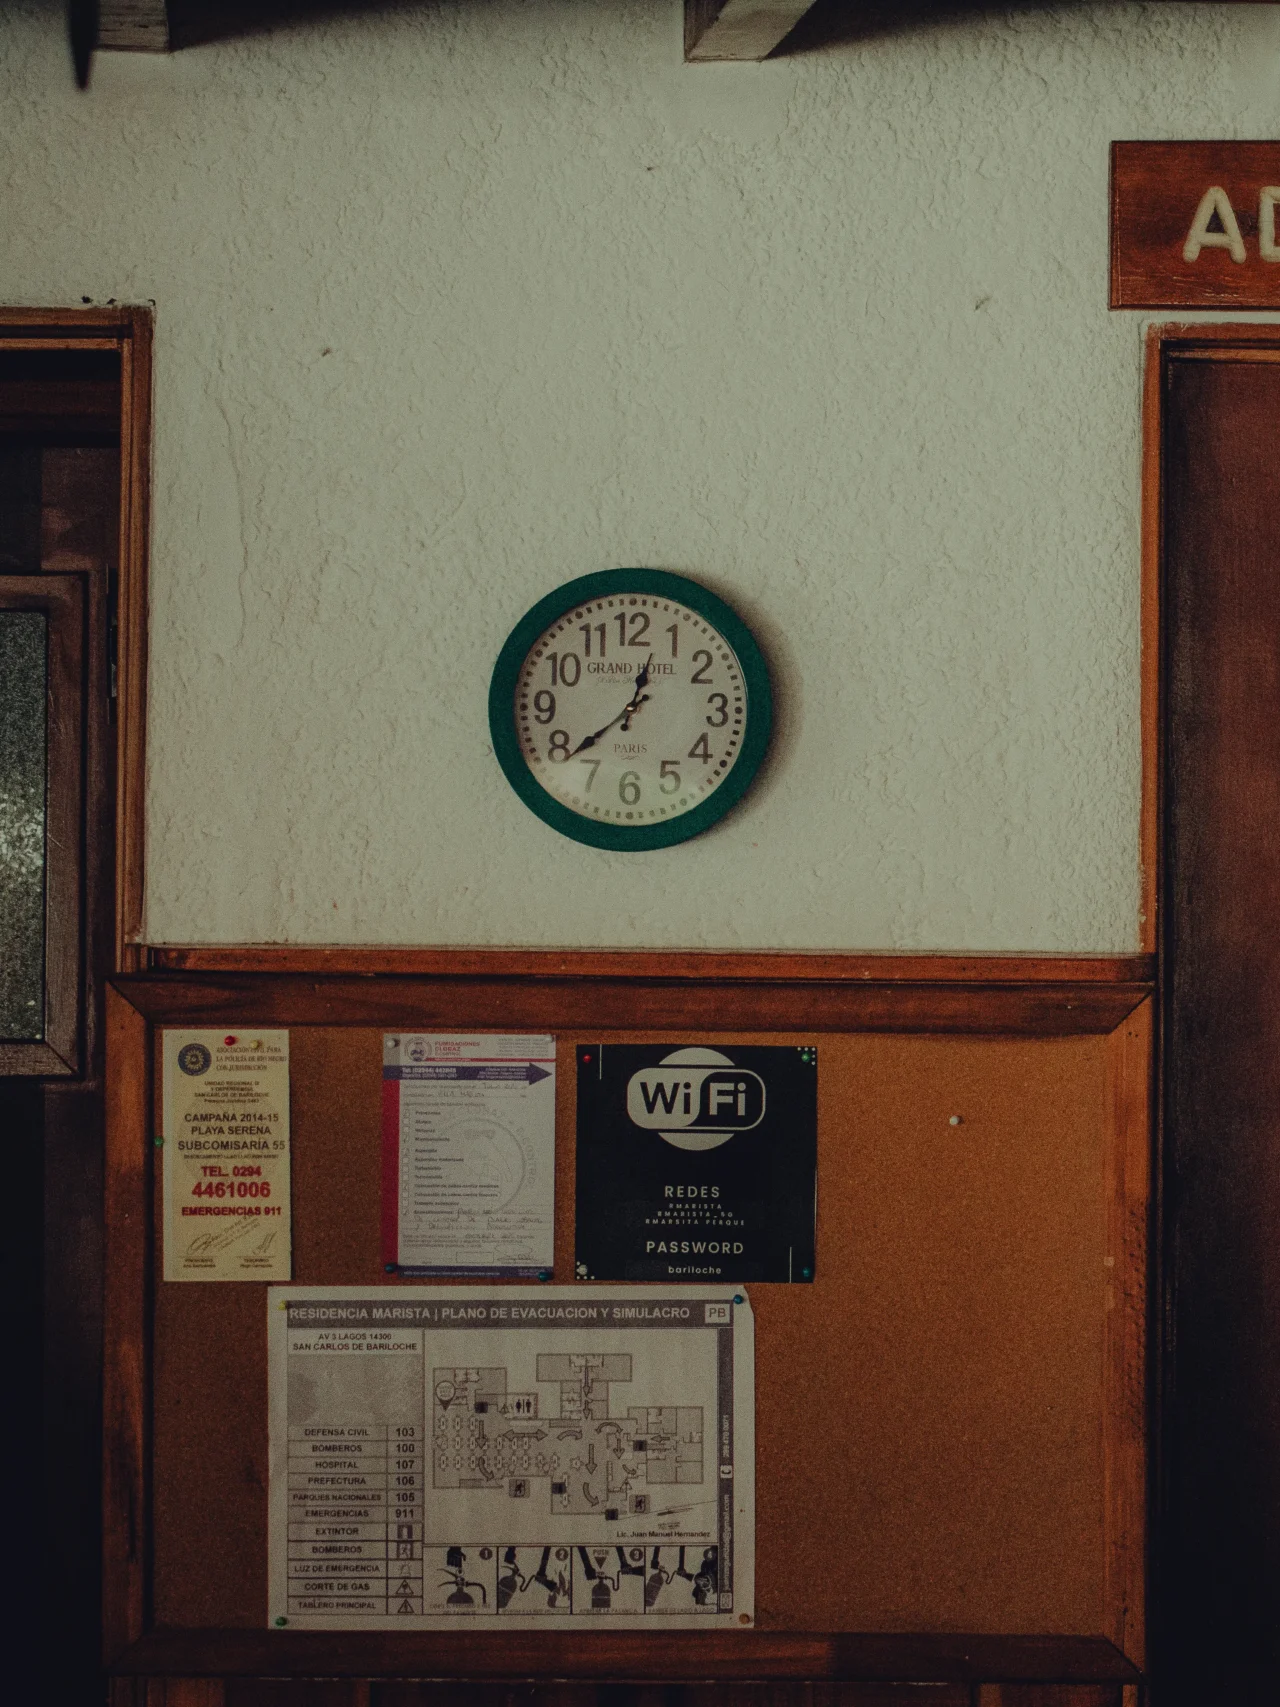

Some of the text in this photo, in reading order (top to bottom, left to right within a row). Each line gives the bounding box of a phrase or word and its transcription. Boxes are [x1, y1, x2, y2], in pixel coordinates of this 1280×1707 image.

[614, 611, 651, 647] 12
[578, 622, 607, 658] 11
[665, 622, 679, 659] 1
[545, 651, 582, 688] 10
[586, 661, 633, 675] GRAND
[690, 649, 714, 685] 2
[533, 689, 557, 725] 9
[706, 692, 729, 728] 3
[547, 728, 571, 764] 8
[613, 743, 648, 755] PARIS
[687, 732, 714, 764] 4
[579, 758, 602, 794] 7
[658, 759, 681, 796] 5
[617, 770, 641, 806] 6
[184, 1111, 280, 1123] CAMPAÑA 2014-15
[190, 1125, 272, 1136] PLAYA SERENA
[177, 1137, 287, 1151] SUBCOMISARÍA 55
[232, 1165, 264, 1177] 0294
[190, 1180, 272, 1199] 4461006
[663, 1184, 721, 1199] REDES
[181, 1205, 282, 1217] EMERGENCIAS 911
[668, 1202, 722, 1210] RMARISTA
[645, 1218, 700, 1226] RMARSITA
[645, 1240, 745, 1256] PASSWORD
[667, 1263, 723, 1276] bariloche
[289, 1307, 727, 1321] RESIDENCIA MARISTA PLANO DE EVACUACION Y SIMULACRO PB
[318, 1333, 330, 1341] AV
[338, 1333, 368, 1341] LAGOS
[293, 1343, 419, 1351] SAN CARLOS DE BARILOCHE
[304, 1427, 416, 1437] DEFENSA CIVIL 103
[311, 1443, 416, 1453] BOMBEROS 100
[314, 1459, 415, 1470] HOSPITAL 107
[307, 1475, 415, 1486] PREFECTURA 106
[292, 1492, 415, 1502] PARQUES NACIONALES 105
[304, 1508, 415, 1518] EMERGENCIAS 911
[315, 1527, 359, 1536] EXTINTOR
[629, 1530, 648, 1538] Juan
[648, 1530, 674, 1538] Manuel
[674, 1530, 712, 1539] Hernandez
[311, 1545, 363, 1554] BOMBEROS
[294, 1564, 381, 1573] LUZ DE EMERGENCIA
[304, 1582, 370, 1591] CORTE DE GAS
[297, 1601, 377, 1610] TABLERO PRINCIPAL
